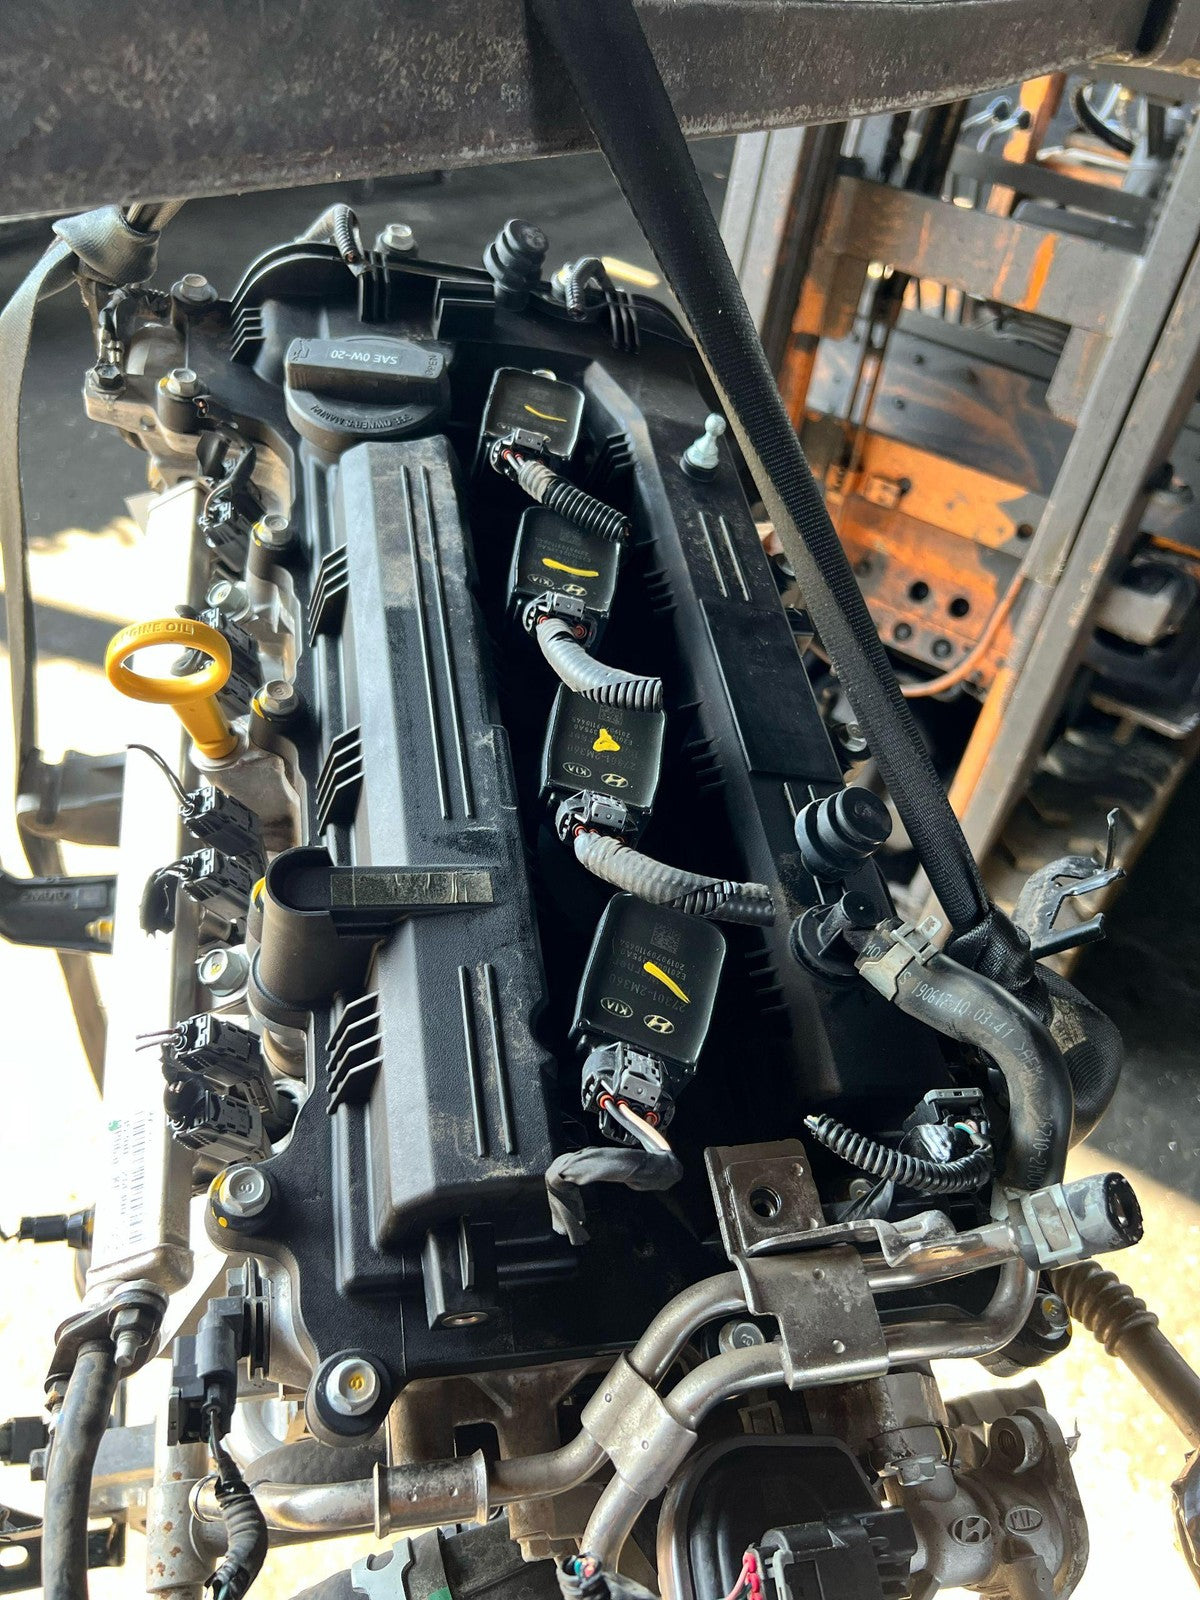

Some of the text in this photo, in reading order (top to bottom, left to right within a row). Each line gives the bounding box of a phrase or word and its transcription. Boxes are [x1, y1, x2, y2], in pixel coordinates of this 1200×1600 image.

[330, 349, 398, 365] SAE 0W-20
[531, 575, 549, 585] KIA
[166, 622, 193, 634] OIL
[567, 764, 587, 775] KIA
[911, 979, 952, 1007] 190617
[607, 1001, 628, 1015] KIA
